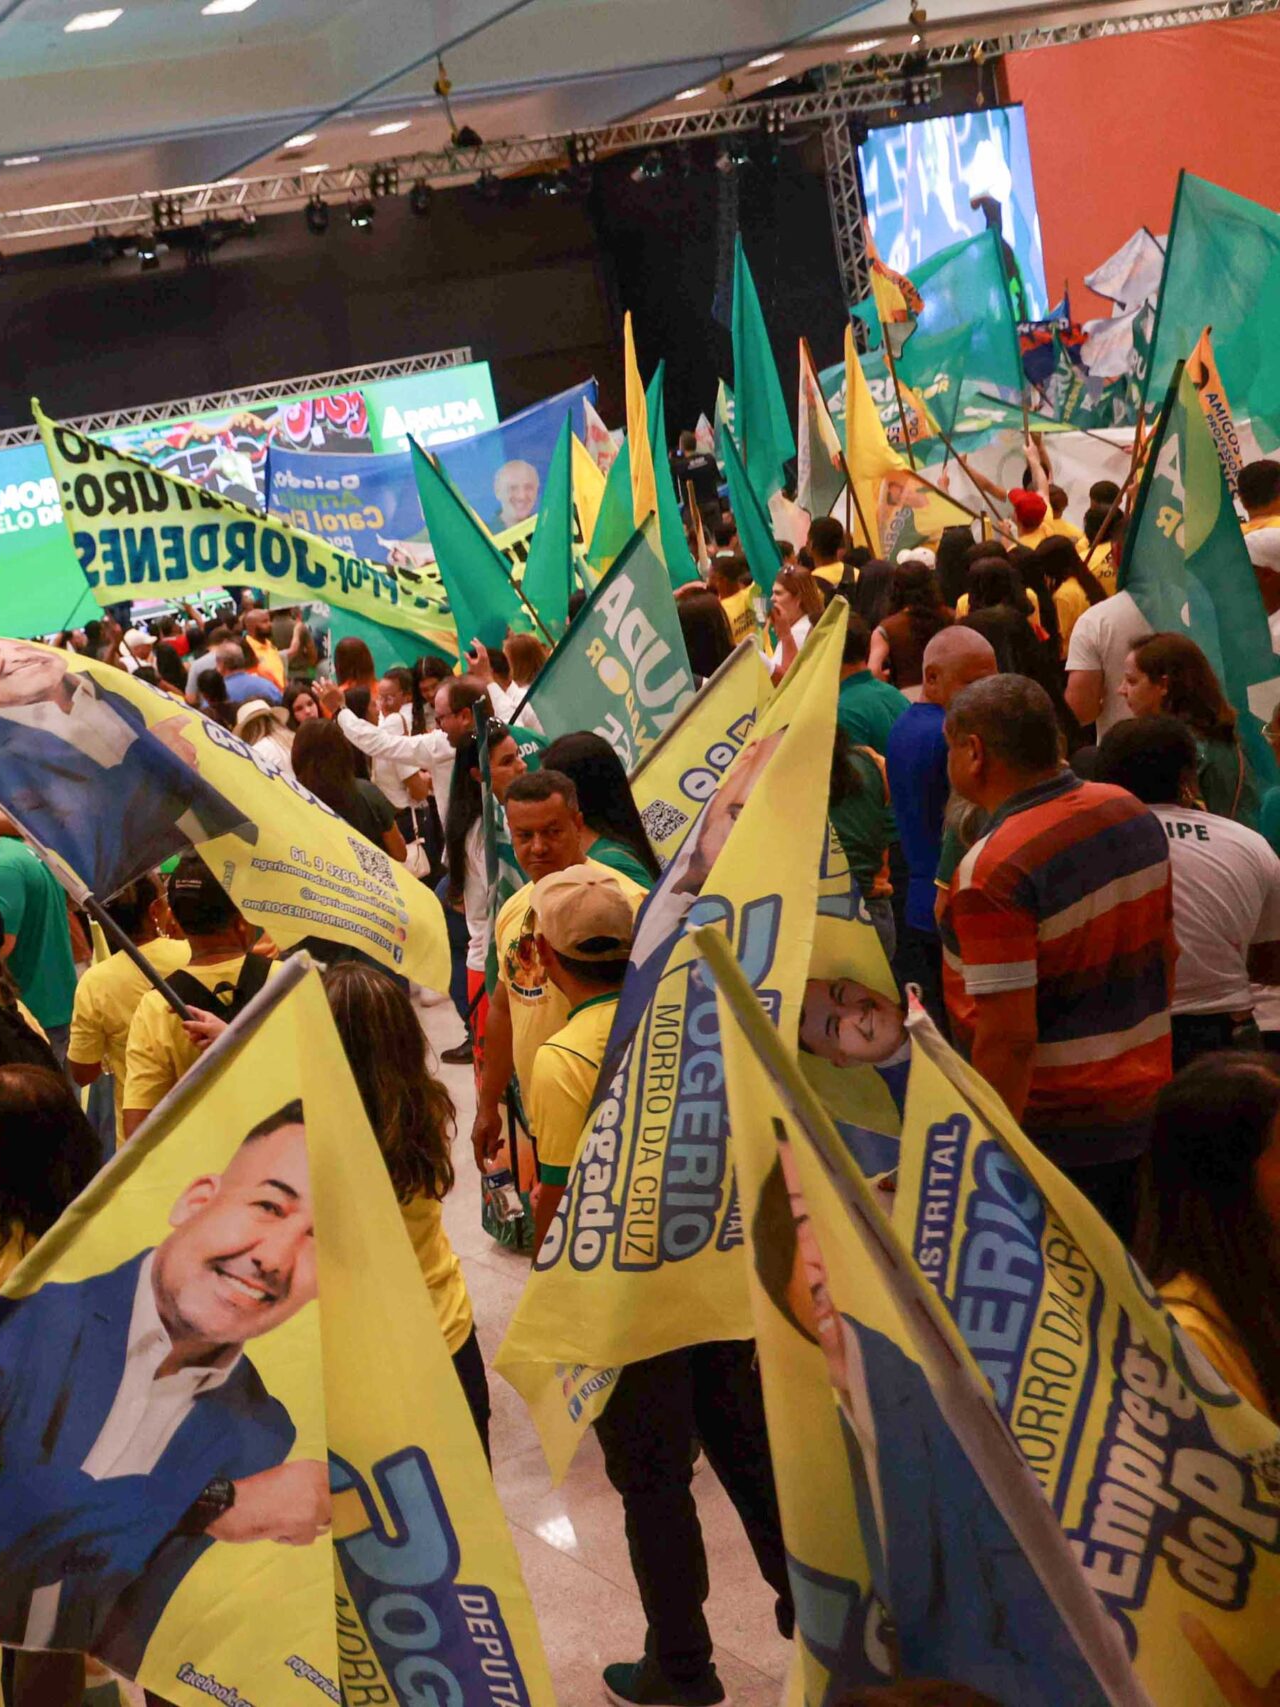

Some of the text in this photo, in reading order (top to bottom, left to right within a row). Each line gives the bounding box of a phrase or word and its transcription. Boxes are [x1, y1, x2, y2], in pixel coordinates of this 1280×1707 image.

[382, 398, 485, 439] ARRUDA
[1165, 821, 1210, 841] IPE
[623, 1003, 683, 1260] MORRO DA CRUZ
[918, 1123, 961, 1283] ISTRITAL
[175, 1661, 257, 1707] facebook.co
